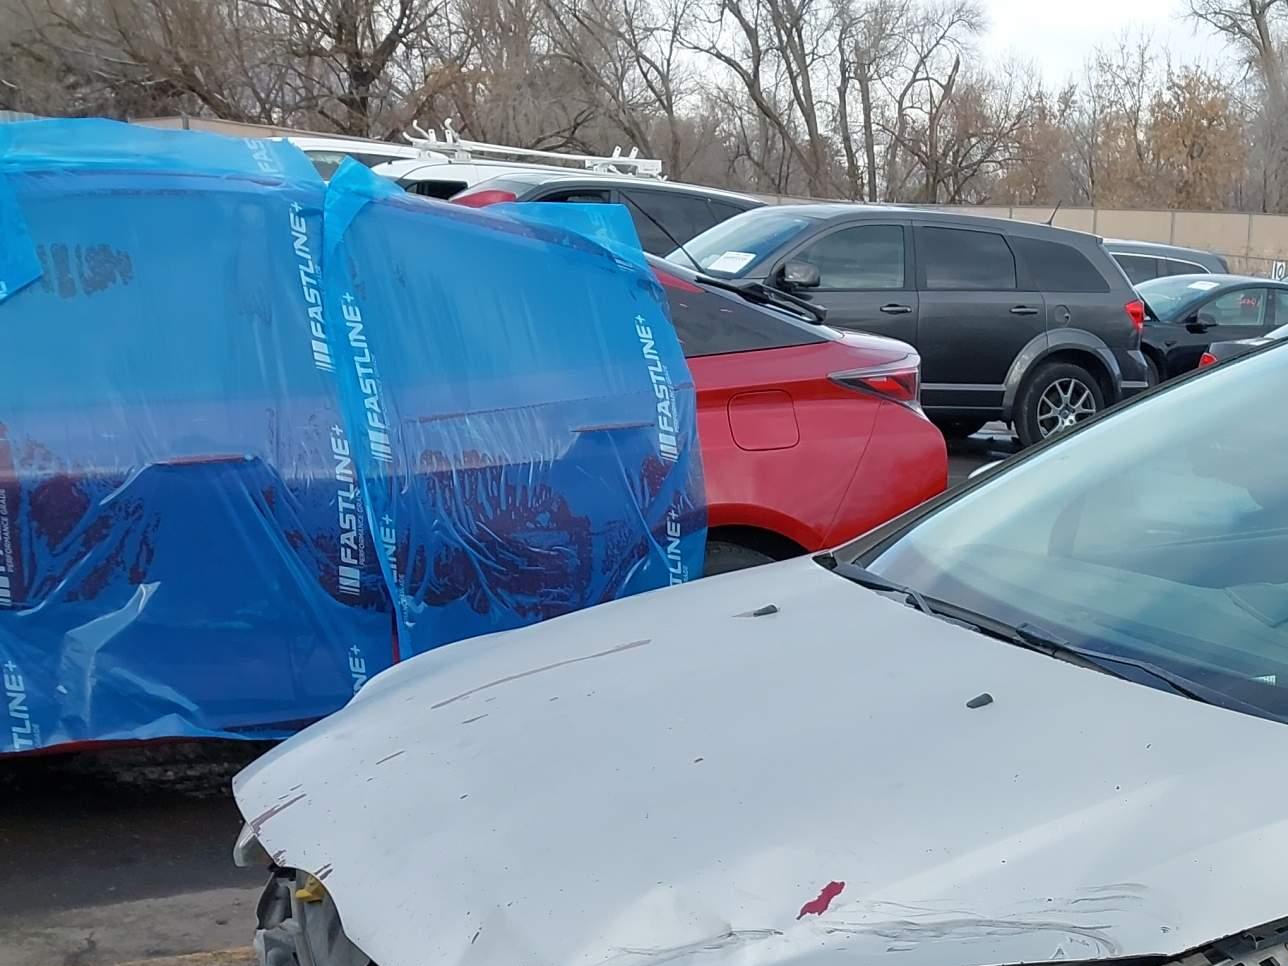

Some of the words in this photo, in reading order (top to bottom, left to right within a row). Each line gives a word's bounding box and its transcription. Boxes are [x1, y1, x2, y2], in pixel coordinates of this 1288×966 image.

[289, 201, 329, 340] FASTLINE+
[341, 292, 385, 429] FASTLINE+
[634, 314, 674, 432] FASTLINE+
[331, 424, 358, 564] FASTLINE+
